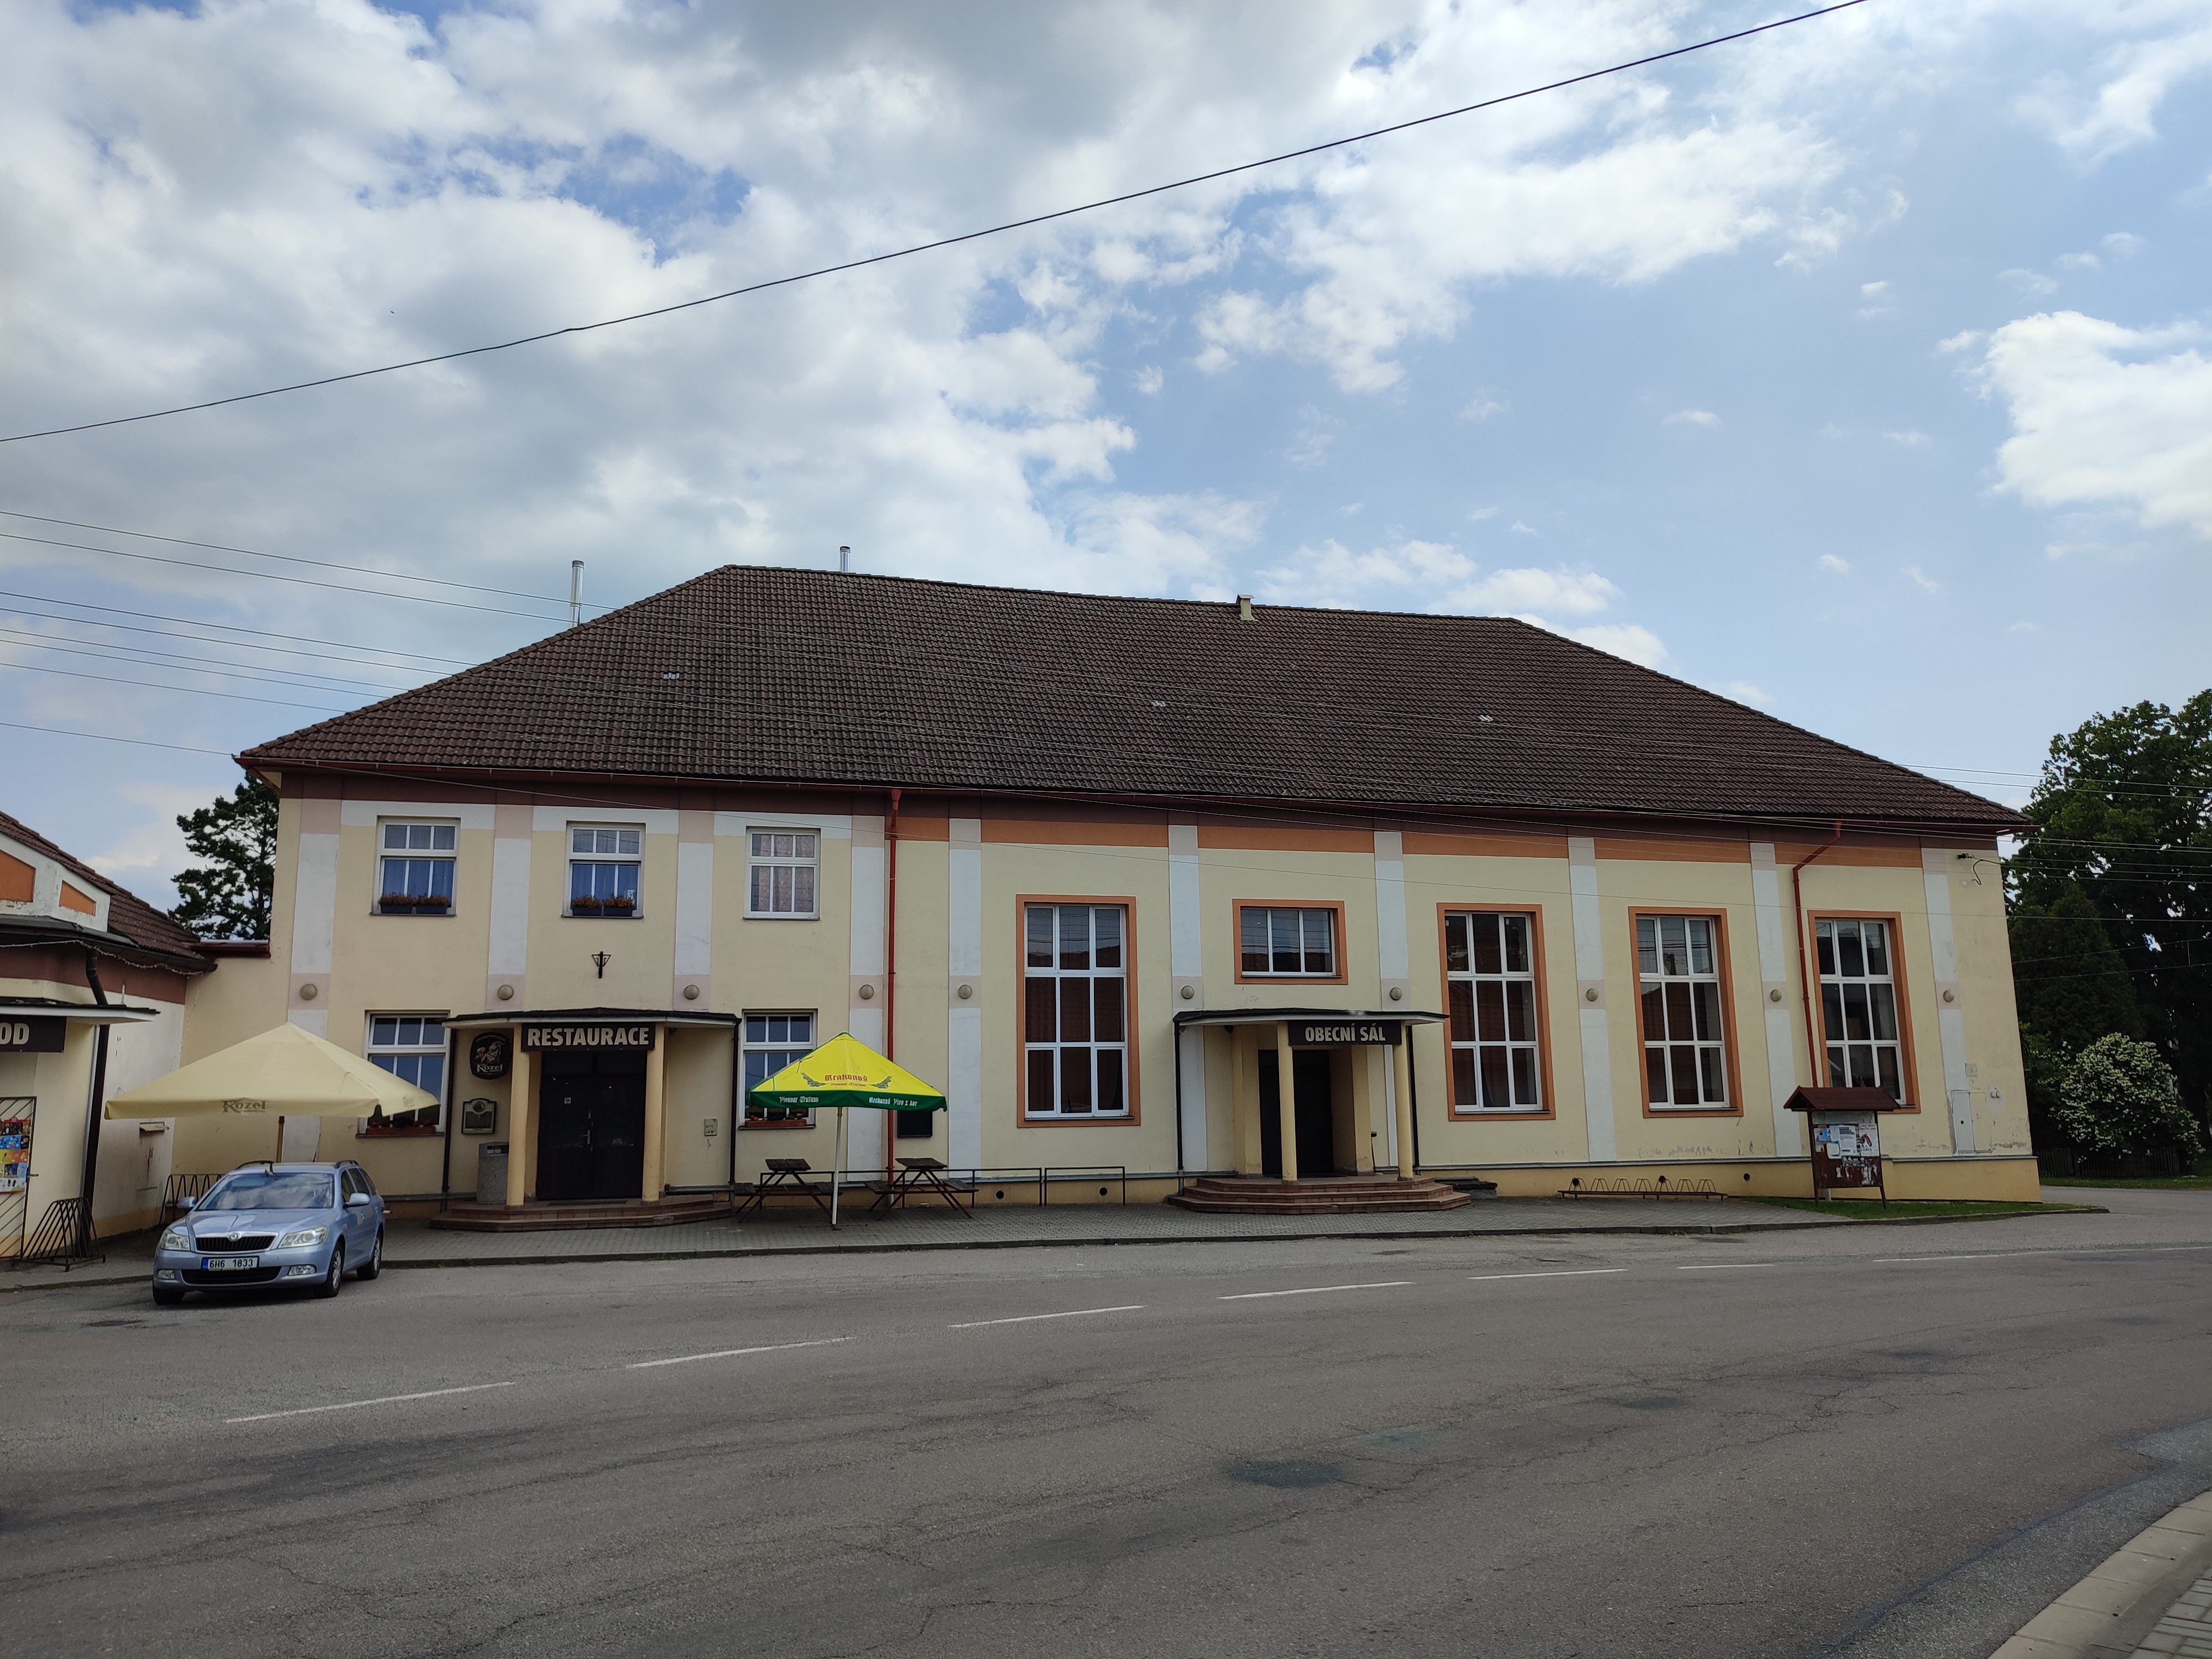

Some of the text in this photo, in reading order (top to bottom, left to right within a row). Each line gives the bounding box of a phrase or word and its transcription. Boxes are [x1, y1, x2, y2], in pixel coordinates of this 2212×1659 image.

[527, 1027, 650, 1046] RESTAURACE
[1305, 1022, 1386, 1042] OBECNÍ SÁL
[476, 1063, 503, 1073] Kozel
[222, 1098, 267, 1113] Kozel
[210, 1259, 253, 1268] 6H6 1833
